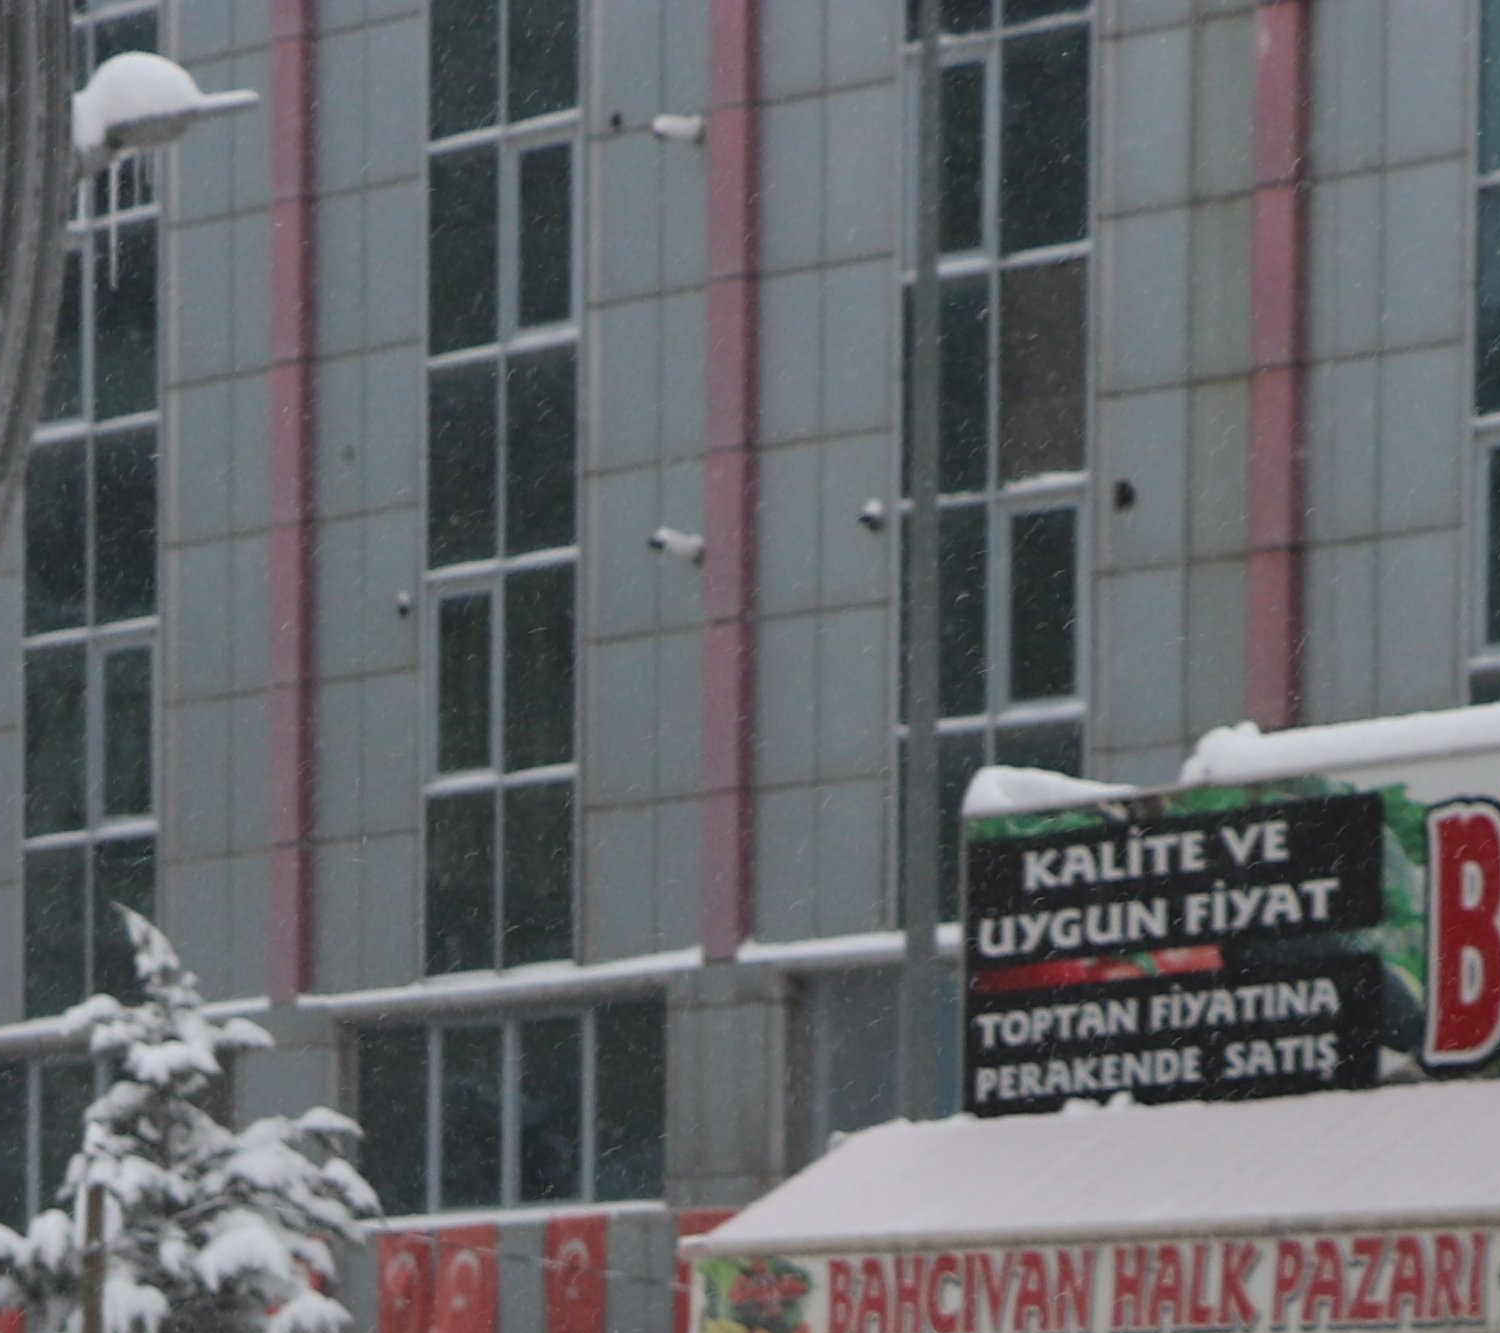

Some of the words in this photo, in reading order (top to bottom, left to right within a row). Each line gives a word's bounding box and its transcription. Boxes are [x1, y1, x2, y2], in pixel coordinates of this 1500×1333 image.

[1022, 824, 1206, 893] KALİTE
[1221, 820, 1290, 866] VE
[979, 900, 1168, 958] UYGUN
[1184, 878, 1341, 936] FİYAT
[977, 999, 1138, 1049] TOPTAN
[1150, 977, 1341, 1031] FİYATINA
[975, 1046, 1201, 1101] PERAKENDE
[1224, 1032, 1339, 1080] SATIŞ
[1271, 1231, 1492, 1331] PAZARI
